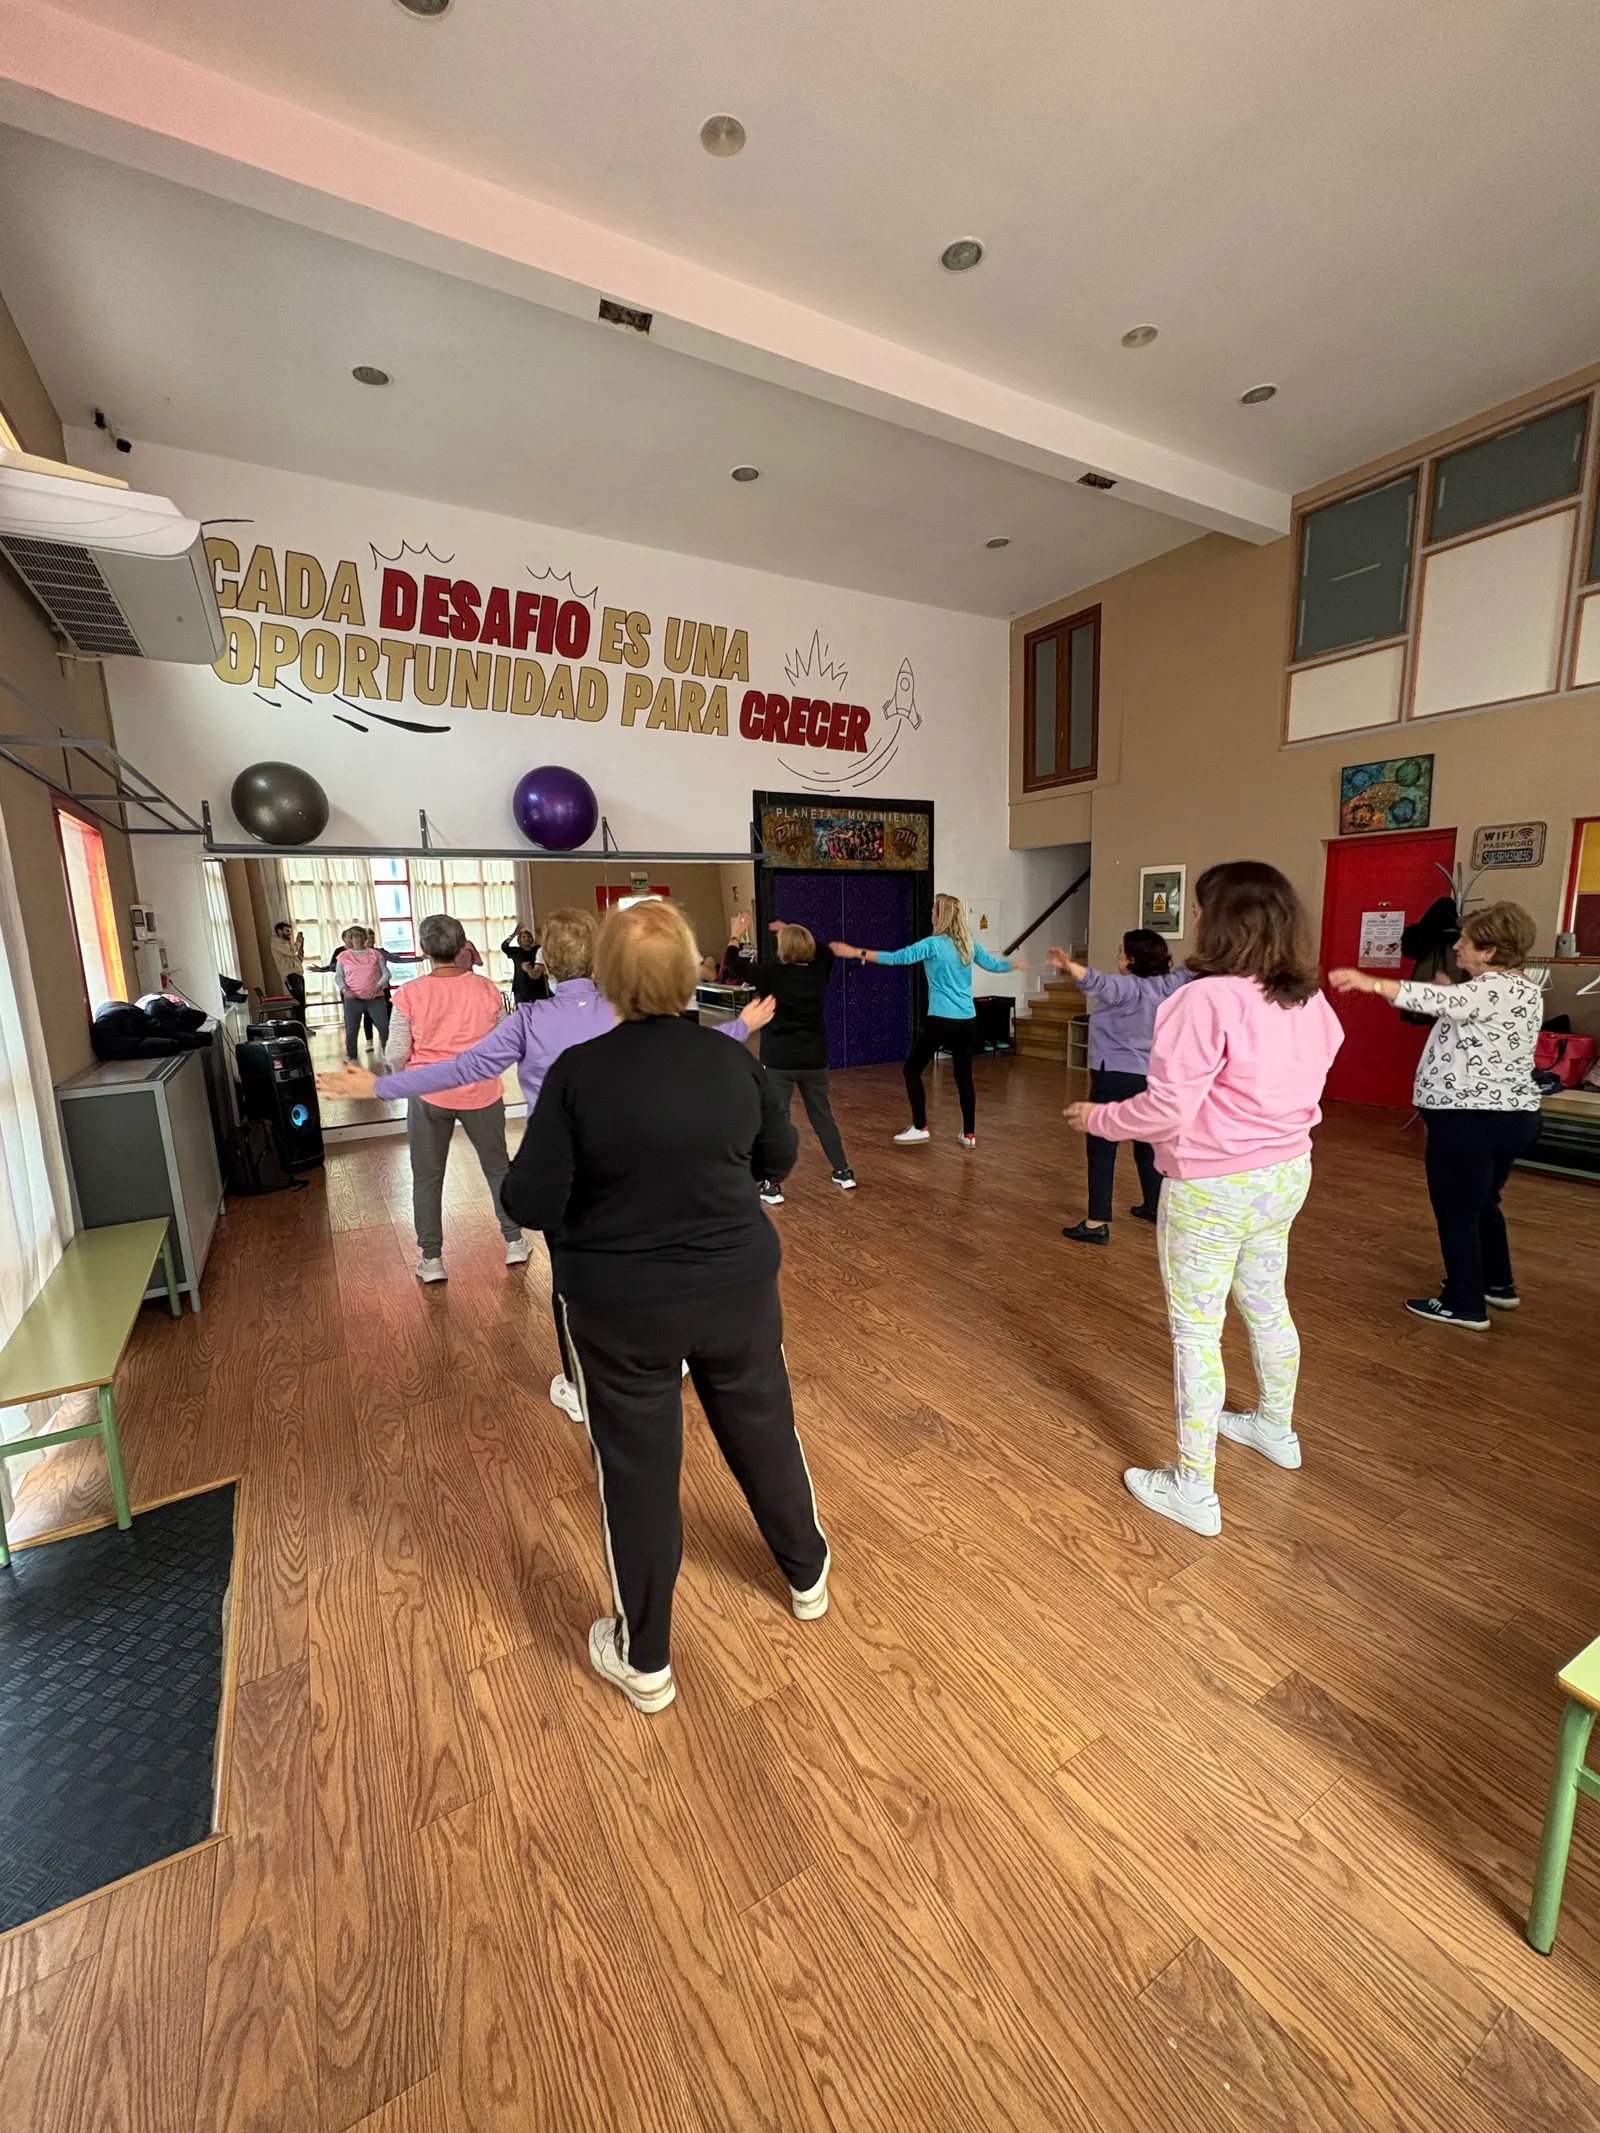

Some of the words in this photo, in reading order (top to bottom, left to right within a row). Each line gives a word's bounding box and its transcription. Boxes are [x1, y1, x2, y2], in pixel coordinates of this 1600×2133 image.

[204, 537, 365, 626] CADA
[379, 567, 591, 659] DESAFIO
[599, 606, 651, 669] ES
[663, 616, 750, 682] UNA
[212, 616, 609, 722] OPORTUNIDAD
[620, 672, 729, 737] PARA
[738, 689, 871, 753] CRECER
[776, 807, 833, 820] PLANETA
[848, 810, 923, 823] MOVIMIENTO
[1484, 830, 1515, 841] WIFI
[1483, 840, 1534, 849] PASSWORD
